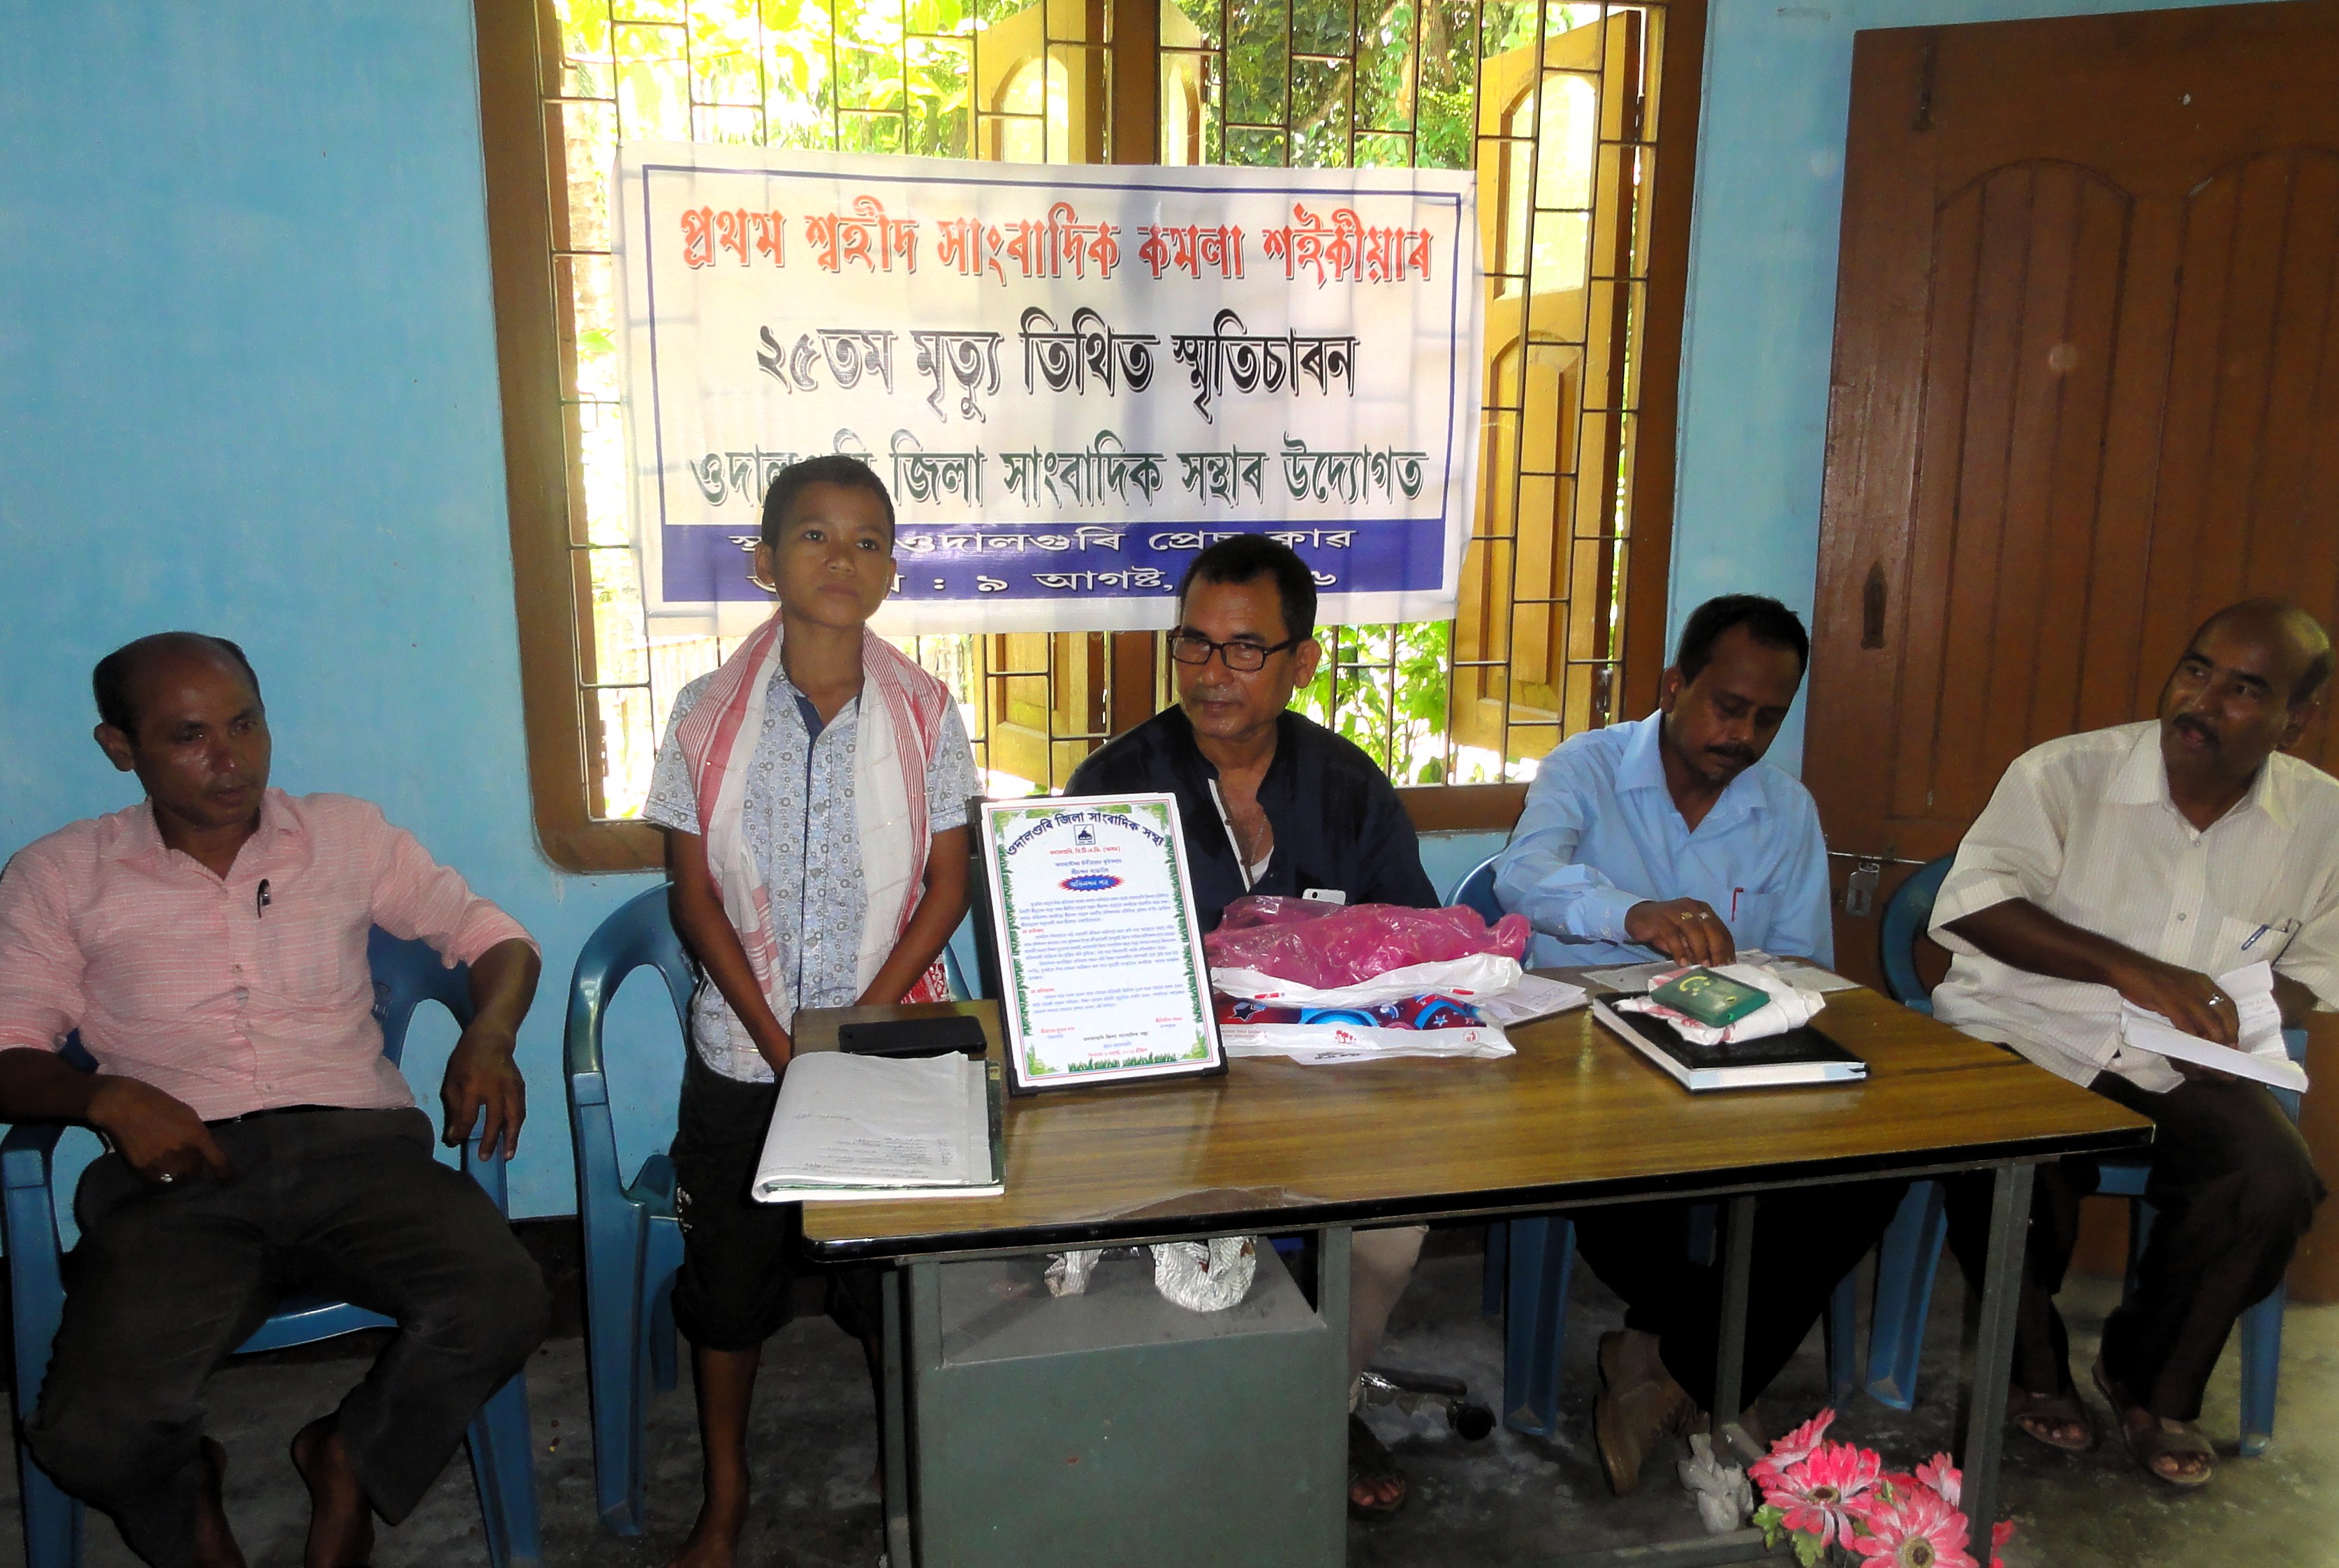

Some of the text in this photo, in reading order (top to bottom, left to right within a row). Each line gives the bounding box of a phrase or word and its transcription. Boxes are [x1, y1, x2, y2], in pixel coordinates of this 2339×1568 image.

[936, 201, 1121, 287] সাংবাদিক
[1137, 221, 1246, 279] কমলা
[756, 325, 898, 394] ২৫তম
[909, 330, 1005, 423] মৃত্যু
[1018, 306, 1161, 397] তিথিত
[888, 428, 989, 507] জিলা
[999, 429, 1167, 509] সাংবাদিক
[1280, 430, 1429, 505] উদ্যোগত
[976, 575, 1009, 592] ৯
[1054, 812, 1085, 826] জিলা
